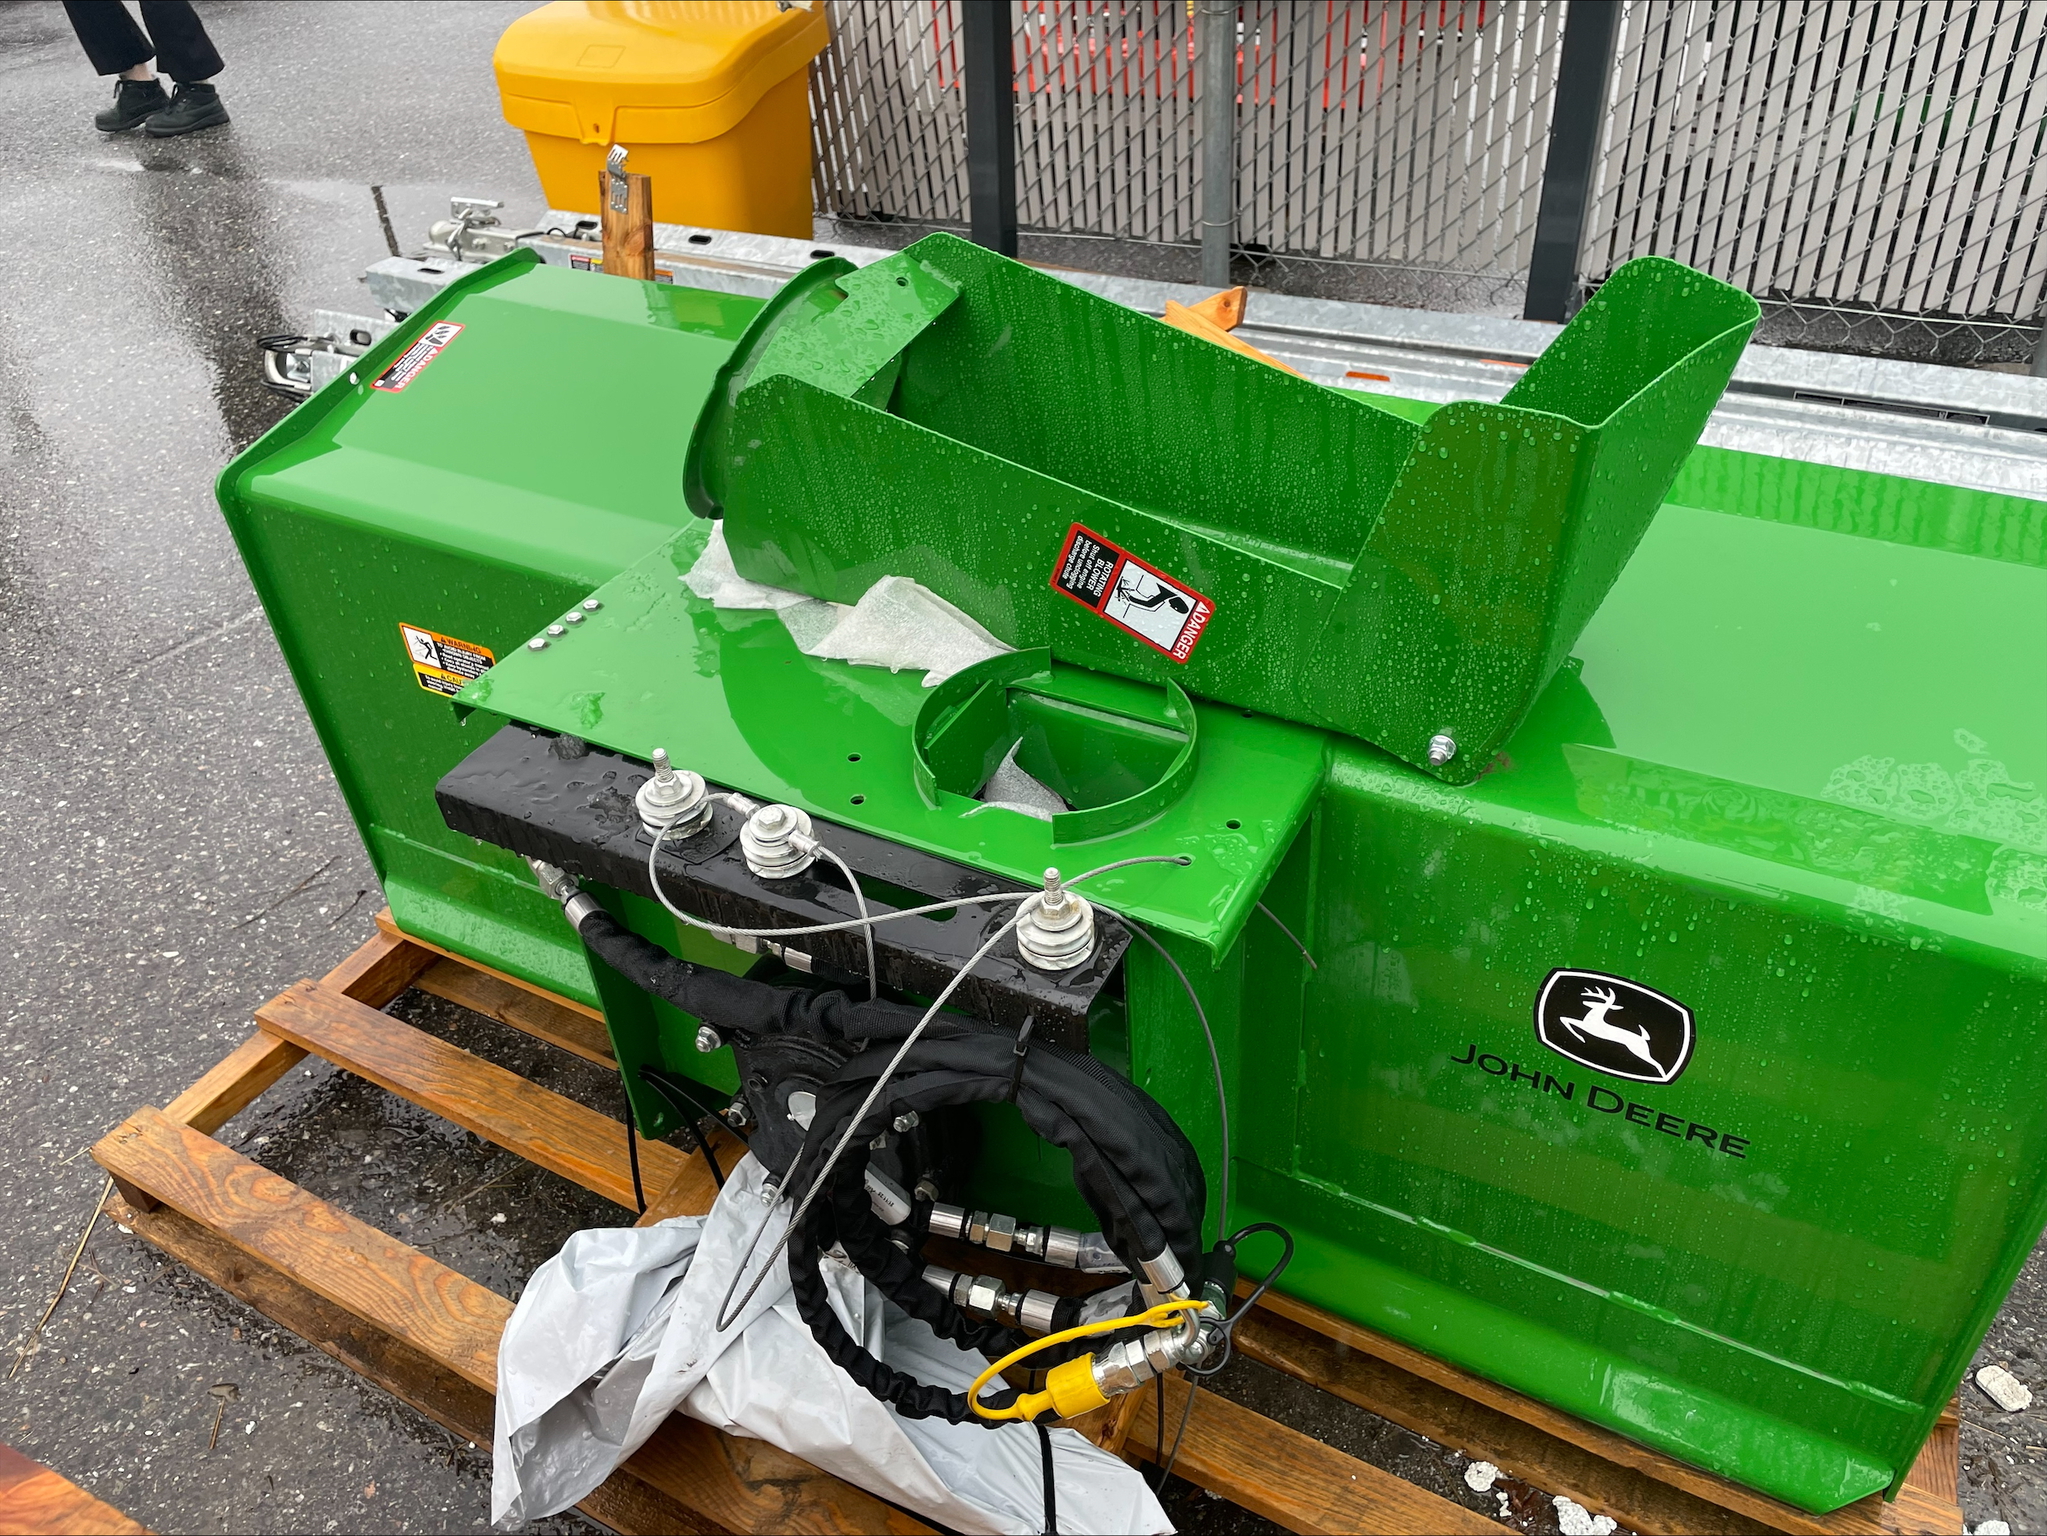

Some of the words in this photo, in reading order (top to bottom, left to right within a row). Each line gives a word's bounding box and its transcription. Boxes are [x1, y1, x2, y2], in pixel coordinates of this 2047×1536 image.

[395, 354, 433, 389] DANGER
[1068, 535, 1084, 564] discharge
[1079, 539, 1092, 559] before
[1088, 544, 1100, 560] Shut
[1062, 562, 1072, 580] chute
[1066, 558, 1083, 590] unclogging
[1076, 568, 1089, 589] engine
[1085, 559, 1093, 570] off
[1086, 558, 1105, 590] BLOWER
[1093, 561, 1114, 597] ROTATING
[446, 638, 482, 653] WARNING
[1172, 611, 1206, 660] DANGER
[1450, 1043, 1576, 1100] JOHN
[1586, 1084, 1750, 1159] DEERE
